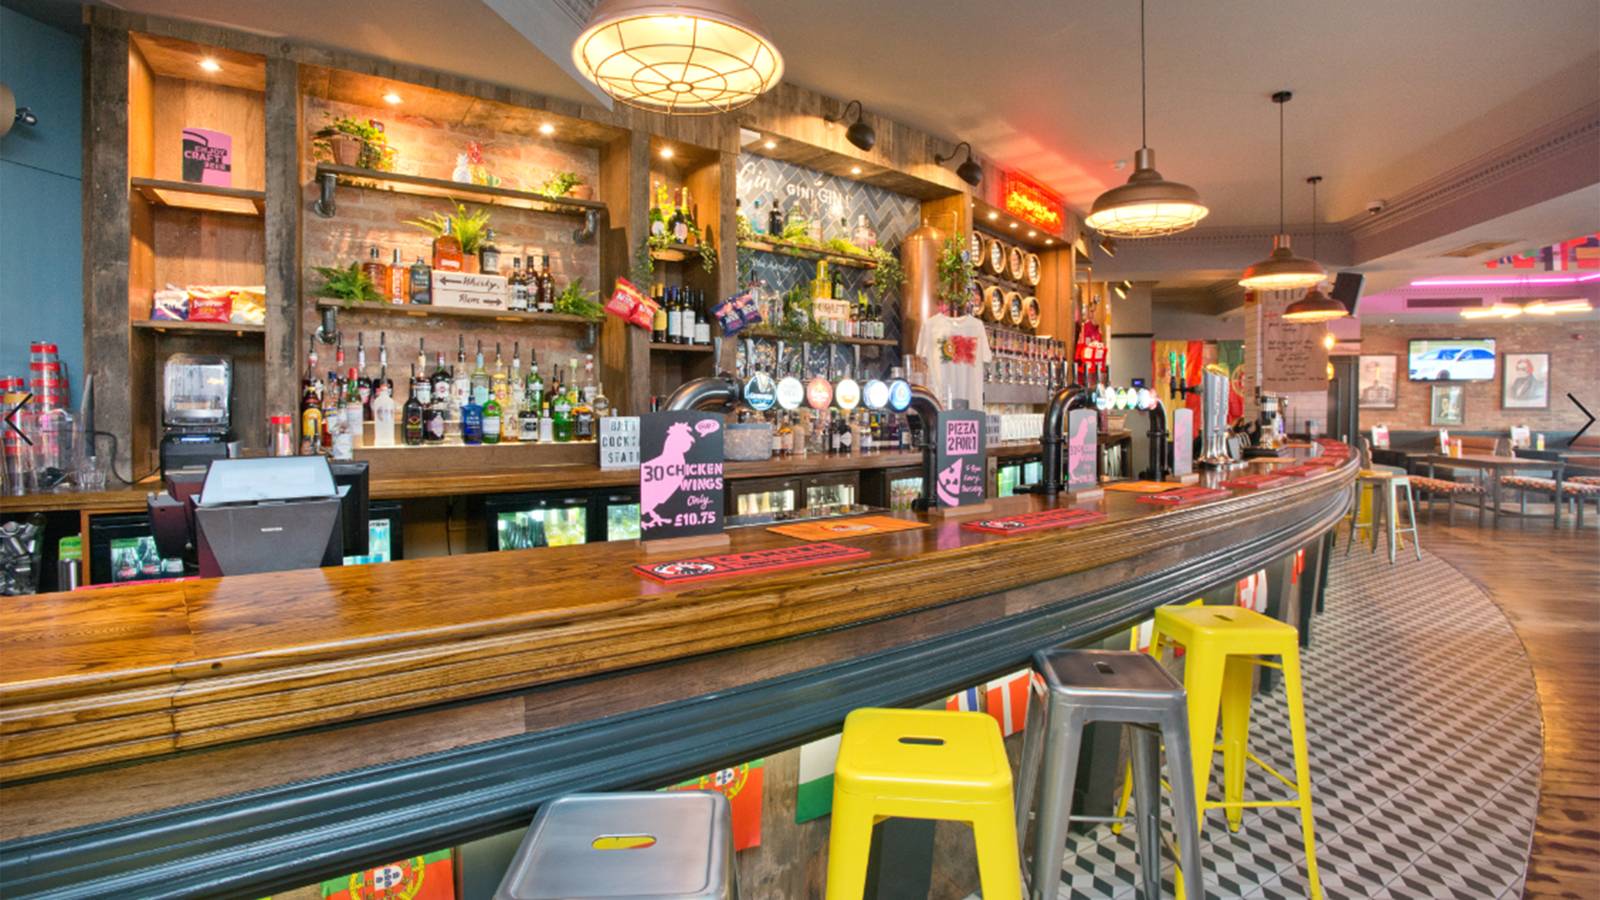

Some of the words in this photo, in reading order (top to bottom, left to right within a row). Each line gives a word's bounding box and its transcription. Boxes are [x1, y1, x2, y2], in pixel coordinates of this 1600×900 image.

[184, 151, 222, 163] CRAFT
[948, 422, 976, 435] PIZZA
[643, 465, 665, 482] 30
[666, 463, 723, 476] CHICKEN
[680, 478, 723, 491] WINGS
[687, 493, 713, 510] Only
[674, 511, 716, 527] £10.75
